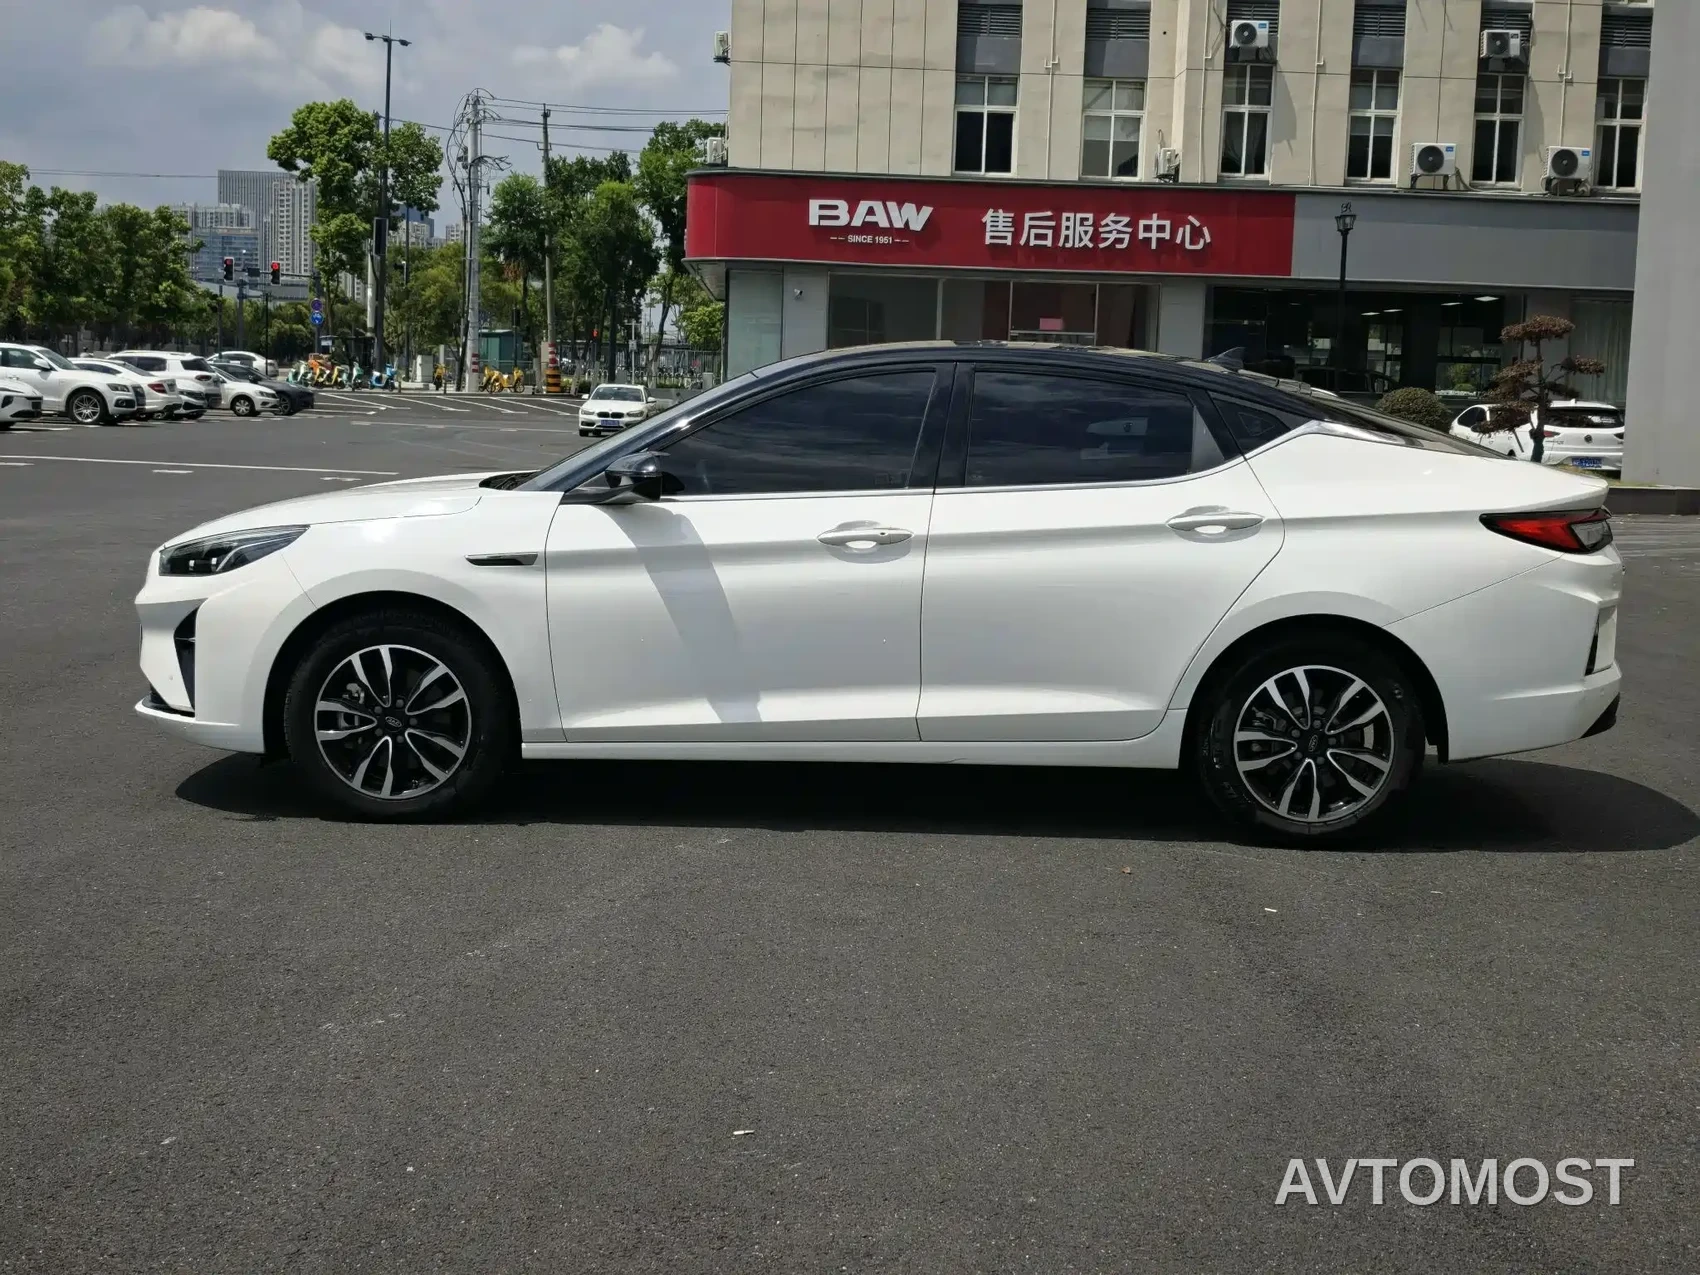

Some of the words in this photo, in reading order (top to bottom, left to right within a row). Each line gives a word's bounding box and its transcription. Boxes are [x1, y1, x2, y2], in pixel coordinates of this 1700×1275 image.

[808, 199, 934, 231] BAW
[981, 208, 1212, 250] 售后服务中心
[847, 234, 873, 244] SINCE
[875, 236, 893, 245] 1951
